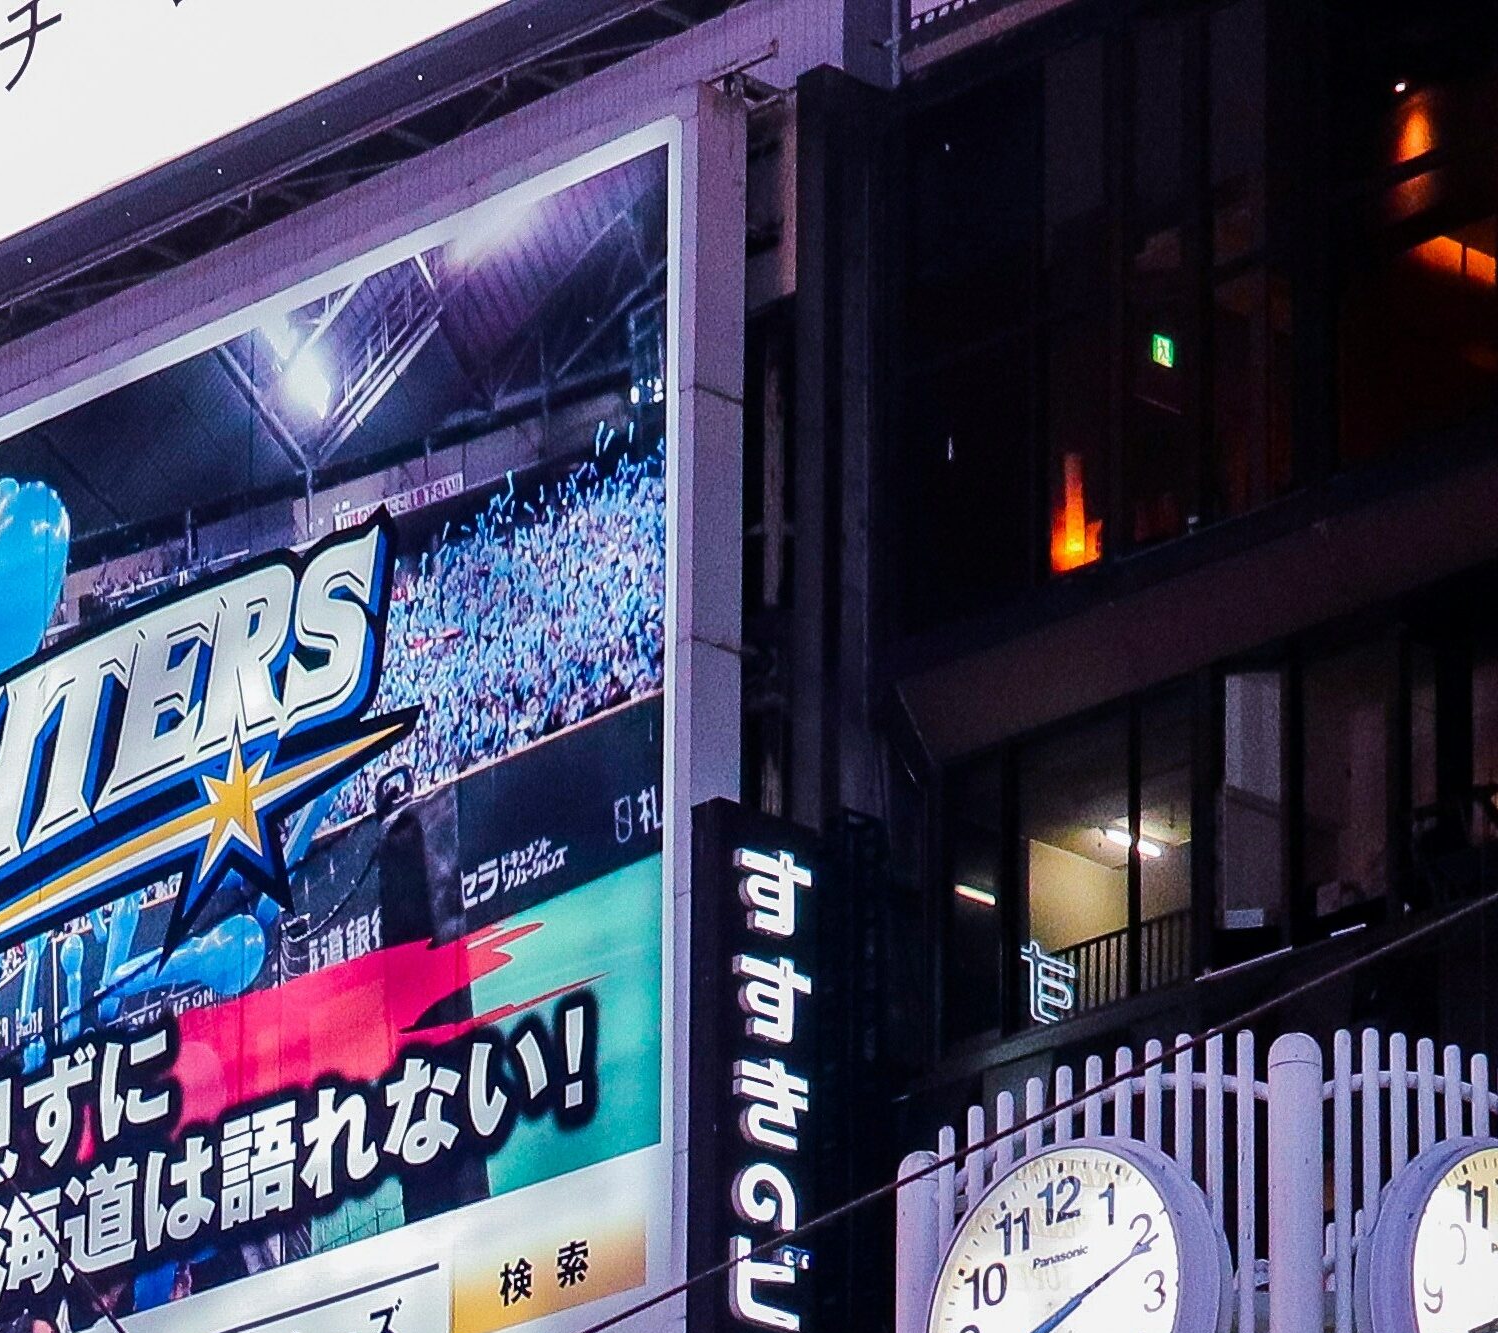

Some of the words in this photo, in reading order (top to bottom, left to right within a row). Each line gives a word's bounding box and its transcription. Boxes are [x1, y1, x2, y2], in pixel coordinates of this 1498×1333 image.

[1037, 1177, 1083, 1224] 12
[1099, 1182, 1116, 1225] 1
[1458, 1181, 1491, 1229] 11
[995, 1209, 1033, 1255] 11
[500, 1240, 590, 1306] 検索
[1032, 1247, 1089, 1271] Panasonic
[964, 1262, 1008, 1309] 10
[1142, 1271, 1167, 1314] 3
